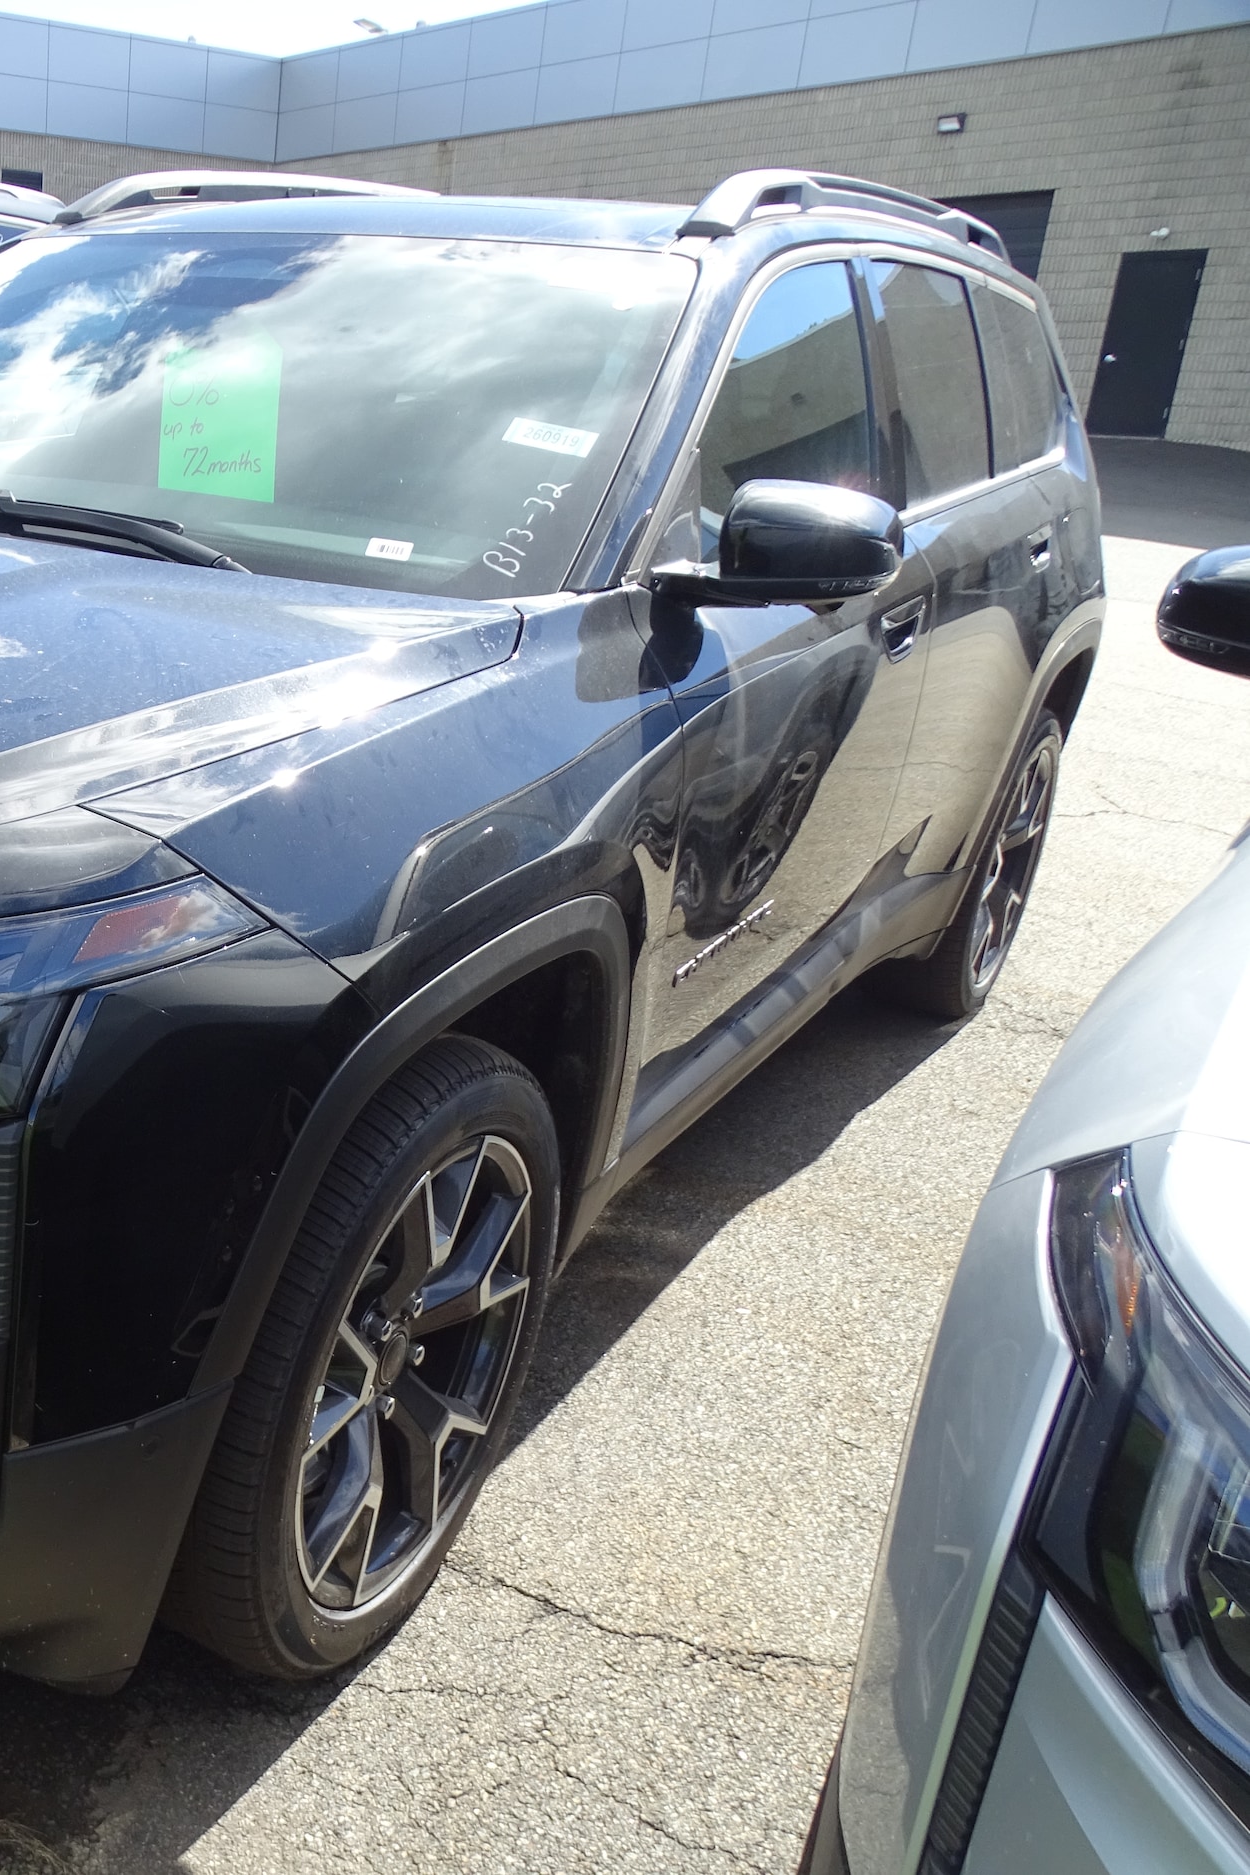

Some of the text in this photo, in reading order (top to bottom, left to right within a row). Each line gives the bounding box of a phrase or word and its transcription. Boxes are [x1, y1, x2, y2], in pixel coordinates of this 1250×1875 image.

[163, 417, 204, 440] up to
[522, 426, 580, 448] 260919
